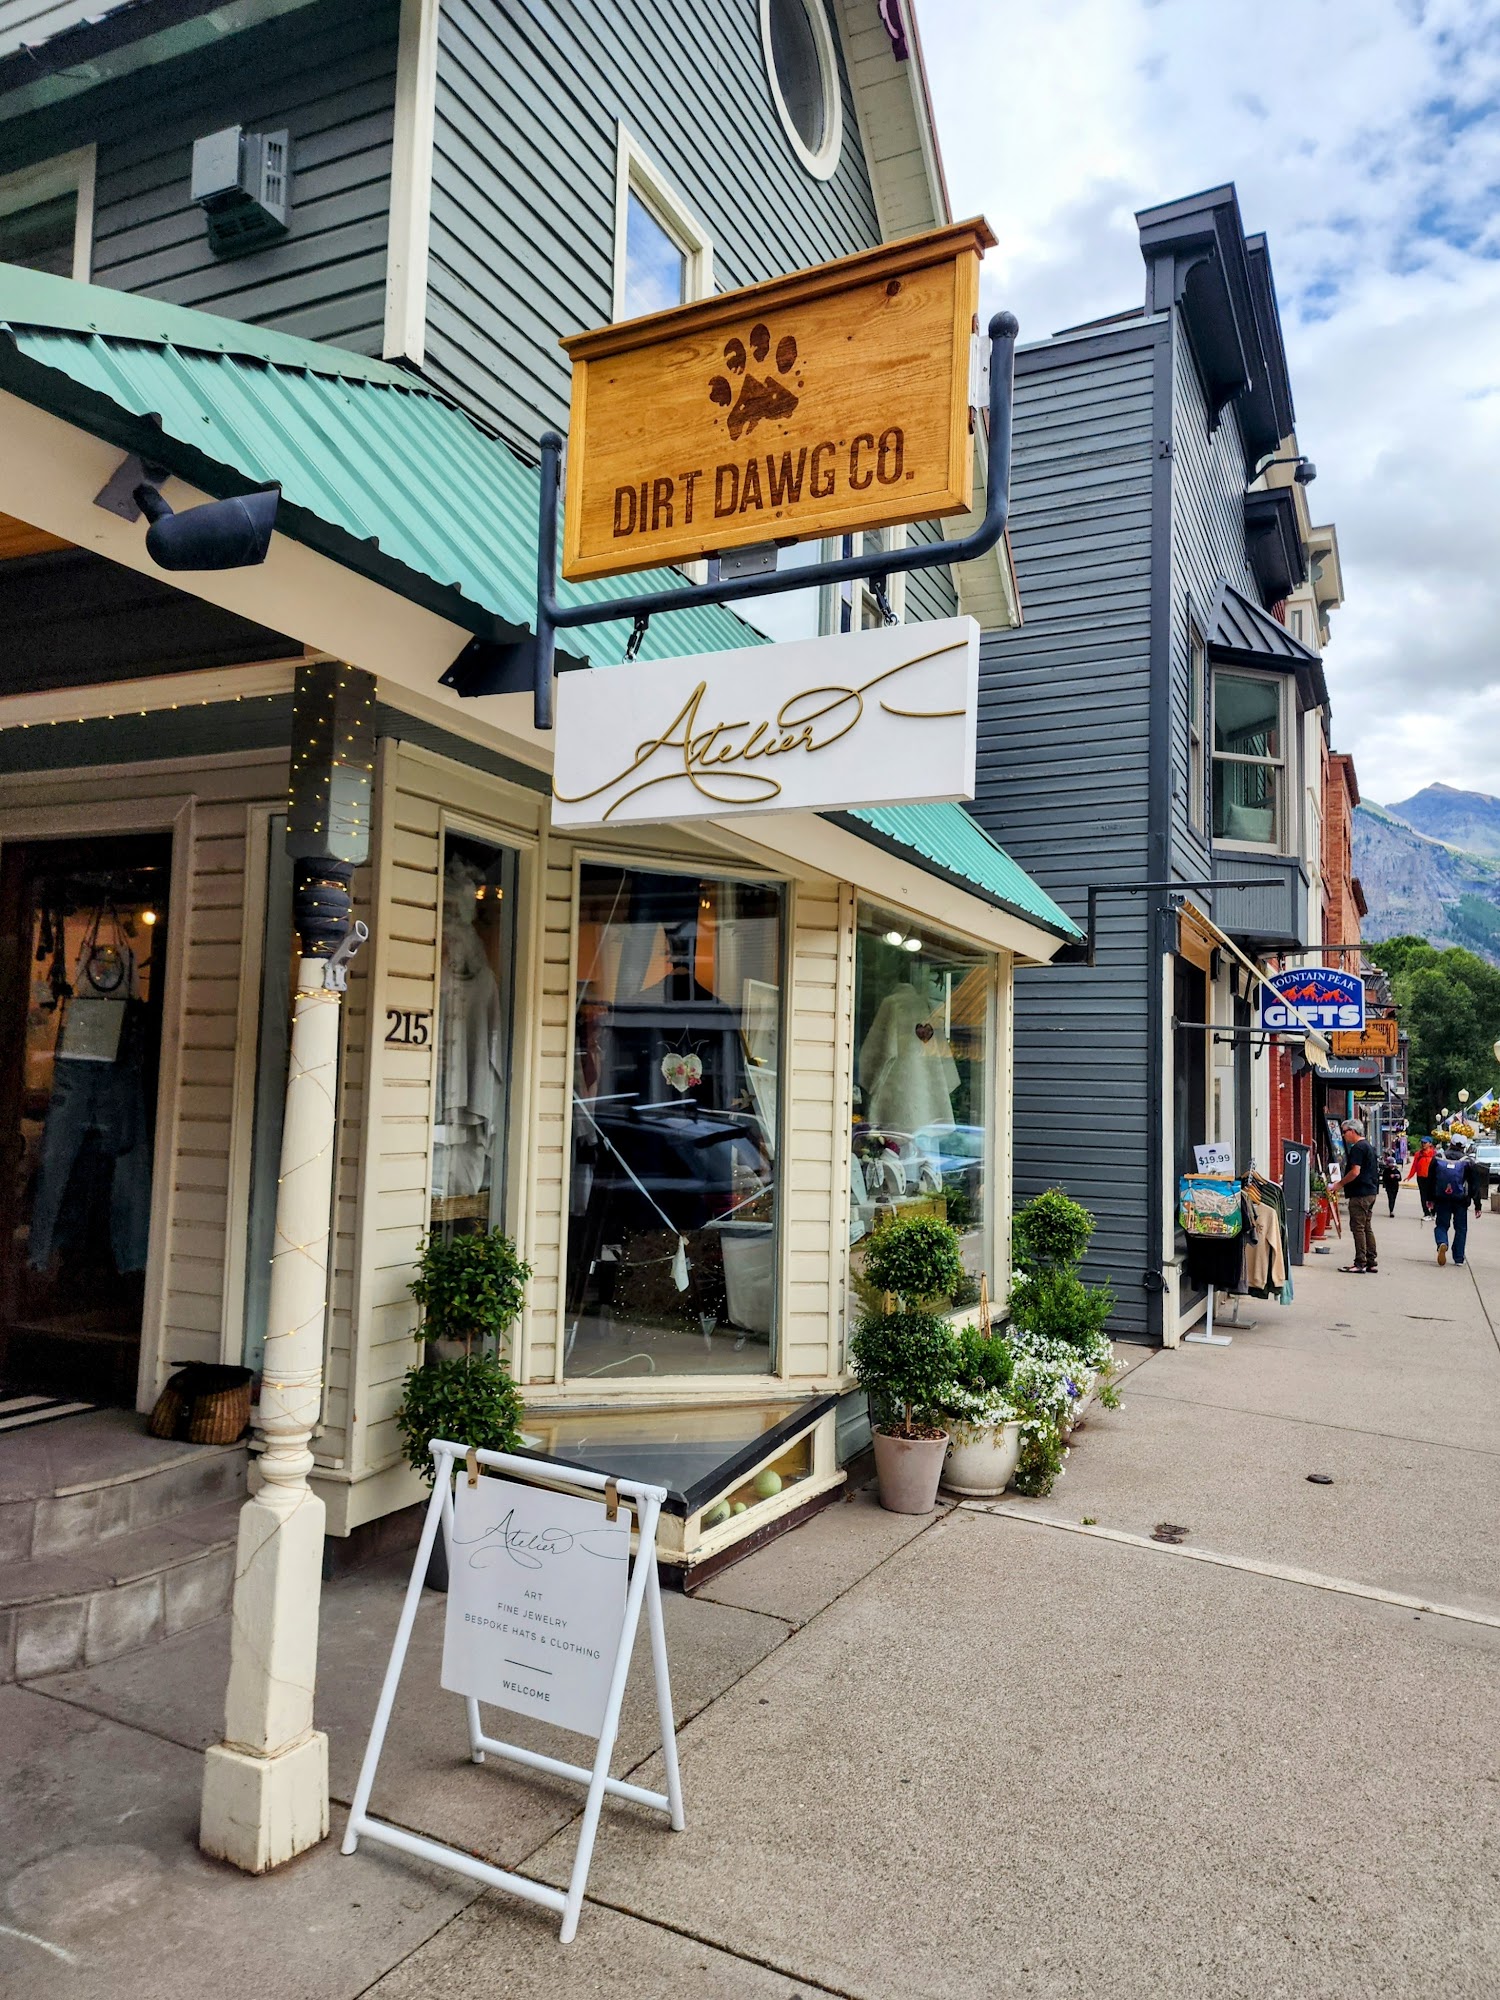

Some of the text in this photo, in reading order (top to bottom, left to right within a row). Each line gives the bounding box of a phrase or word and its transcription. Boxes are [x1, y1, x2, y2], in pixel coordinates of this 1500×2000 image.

[612, 425, 915, 539] DIRT DAWG CO.
[1327, 974, 1357, 991] PEAK
[1264, 1005, 1360, 1026] GIFTS
[385, 1010, 428, 1045] 215
[1198, 1154, 1230, 1166] $19.99
[524, 1589, 543, 1601] ART
[497, 1602, 568, 1628] FINE JEWELRY
[464, 1613, 600, 1660] BESPOKE HATS & CLOTHING
[502, 1680, 551, 1702] WELCOME
